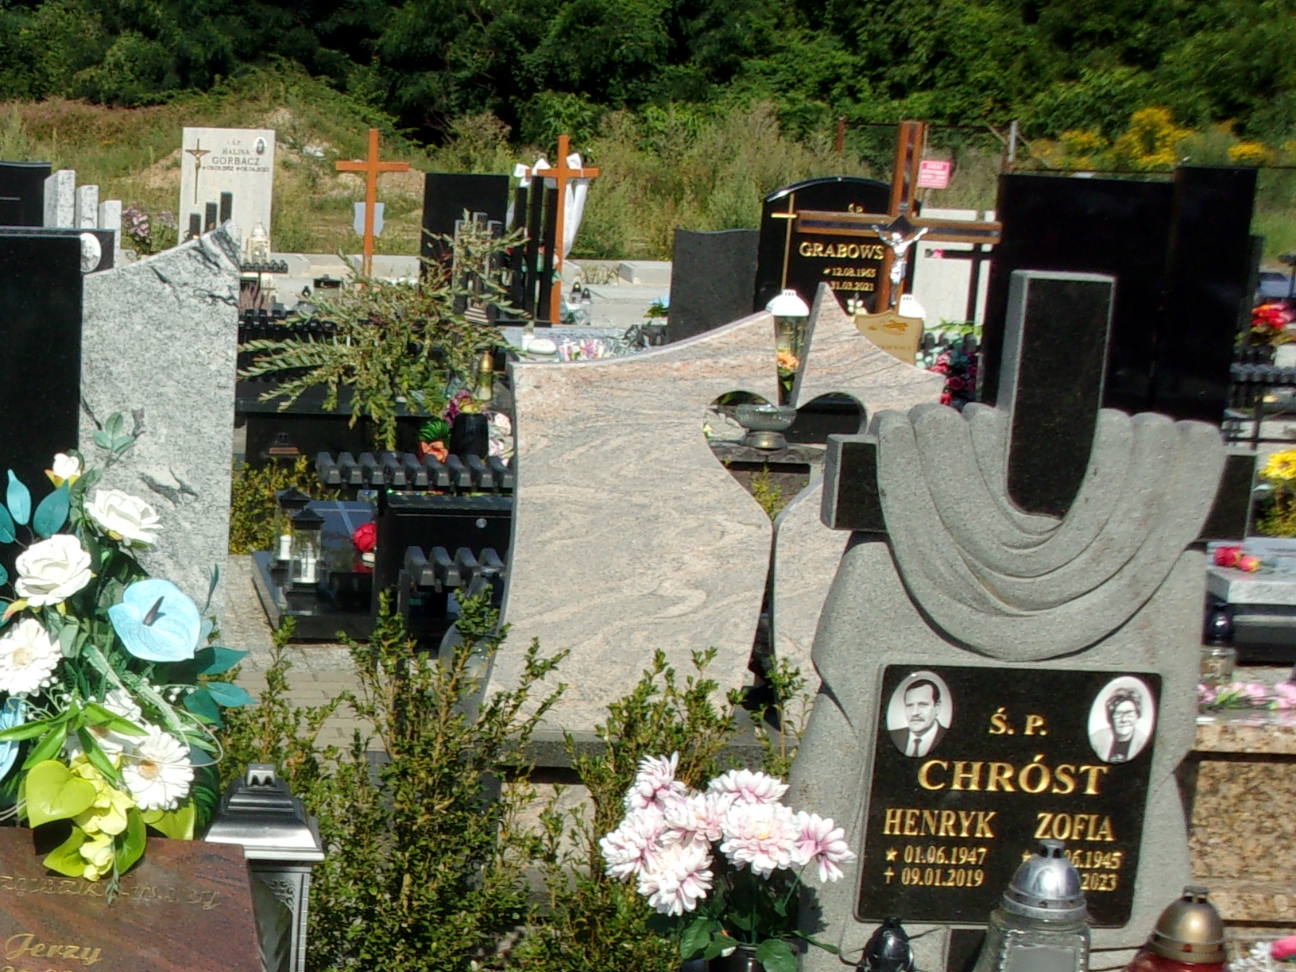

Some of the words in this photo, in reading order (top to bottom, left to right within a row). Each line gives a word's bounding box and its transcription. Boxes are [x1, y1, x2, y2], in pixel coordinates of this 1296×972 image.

[988, 706, 1015, 736] Ś.
[1024, 713, 1049, 737] P.
[917, 755, 1111, 796] CHRÓST
[882, 808, 997, 839] HENRYK
[1033, 812, 1116, 842] ZOFIA
[903, 845, 988, 866] 01.06.1947
[901, 867, 985, 888] 09.01.2019
[4, 933, 104, 967] Jerzy
